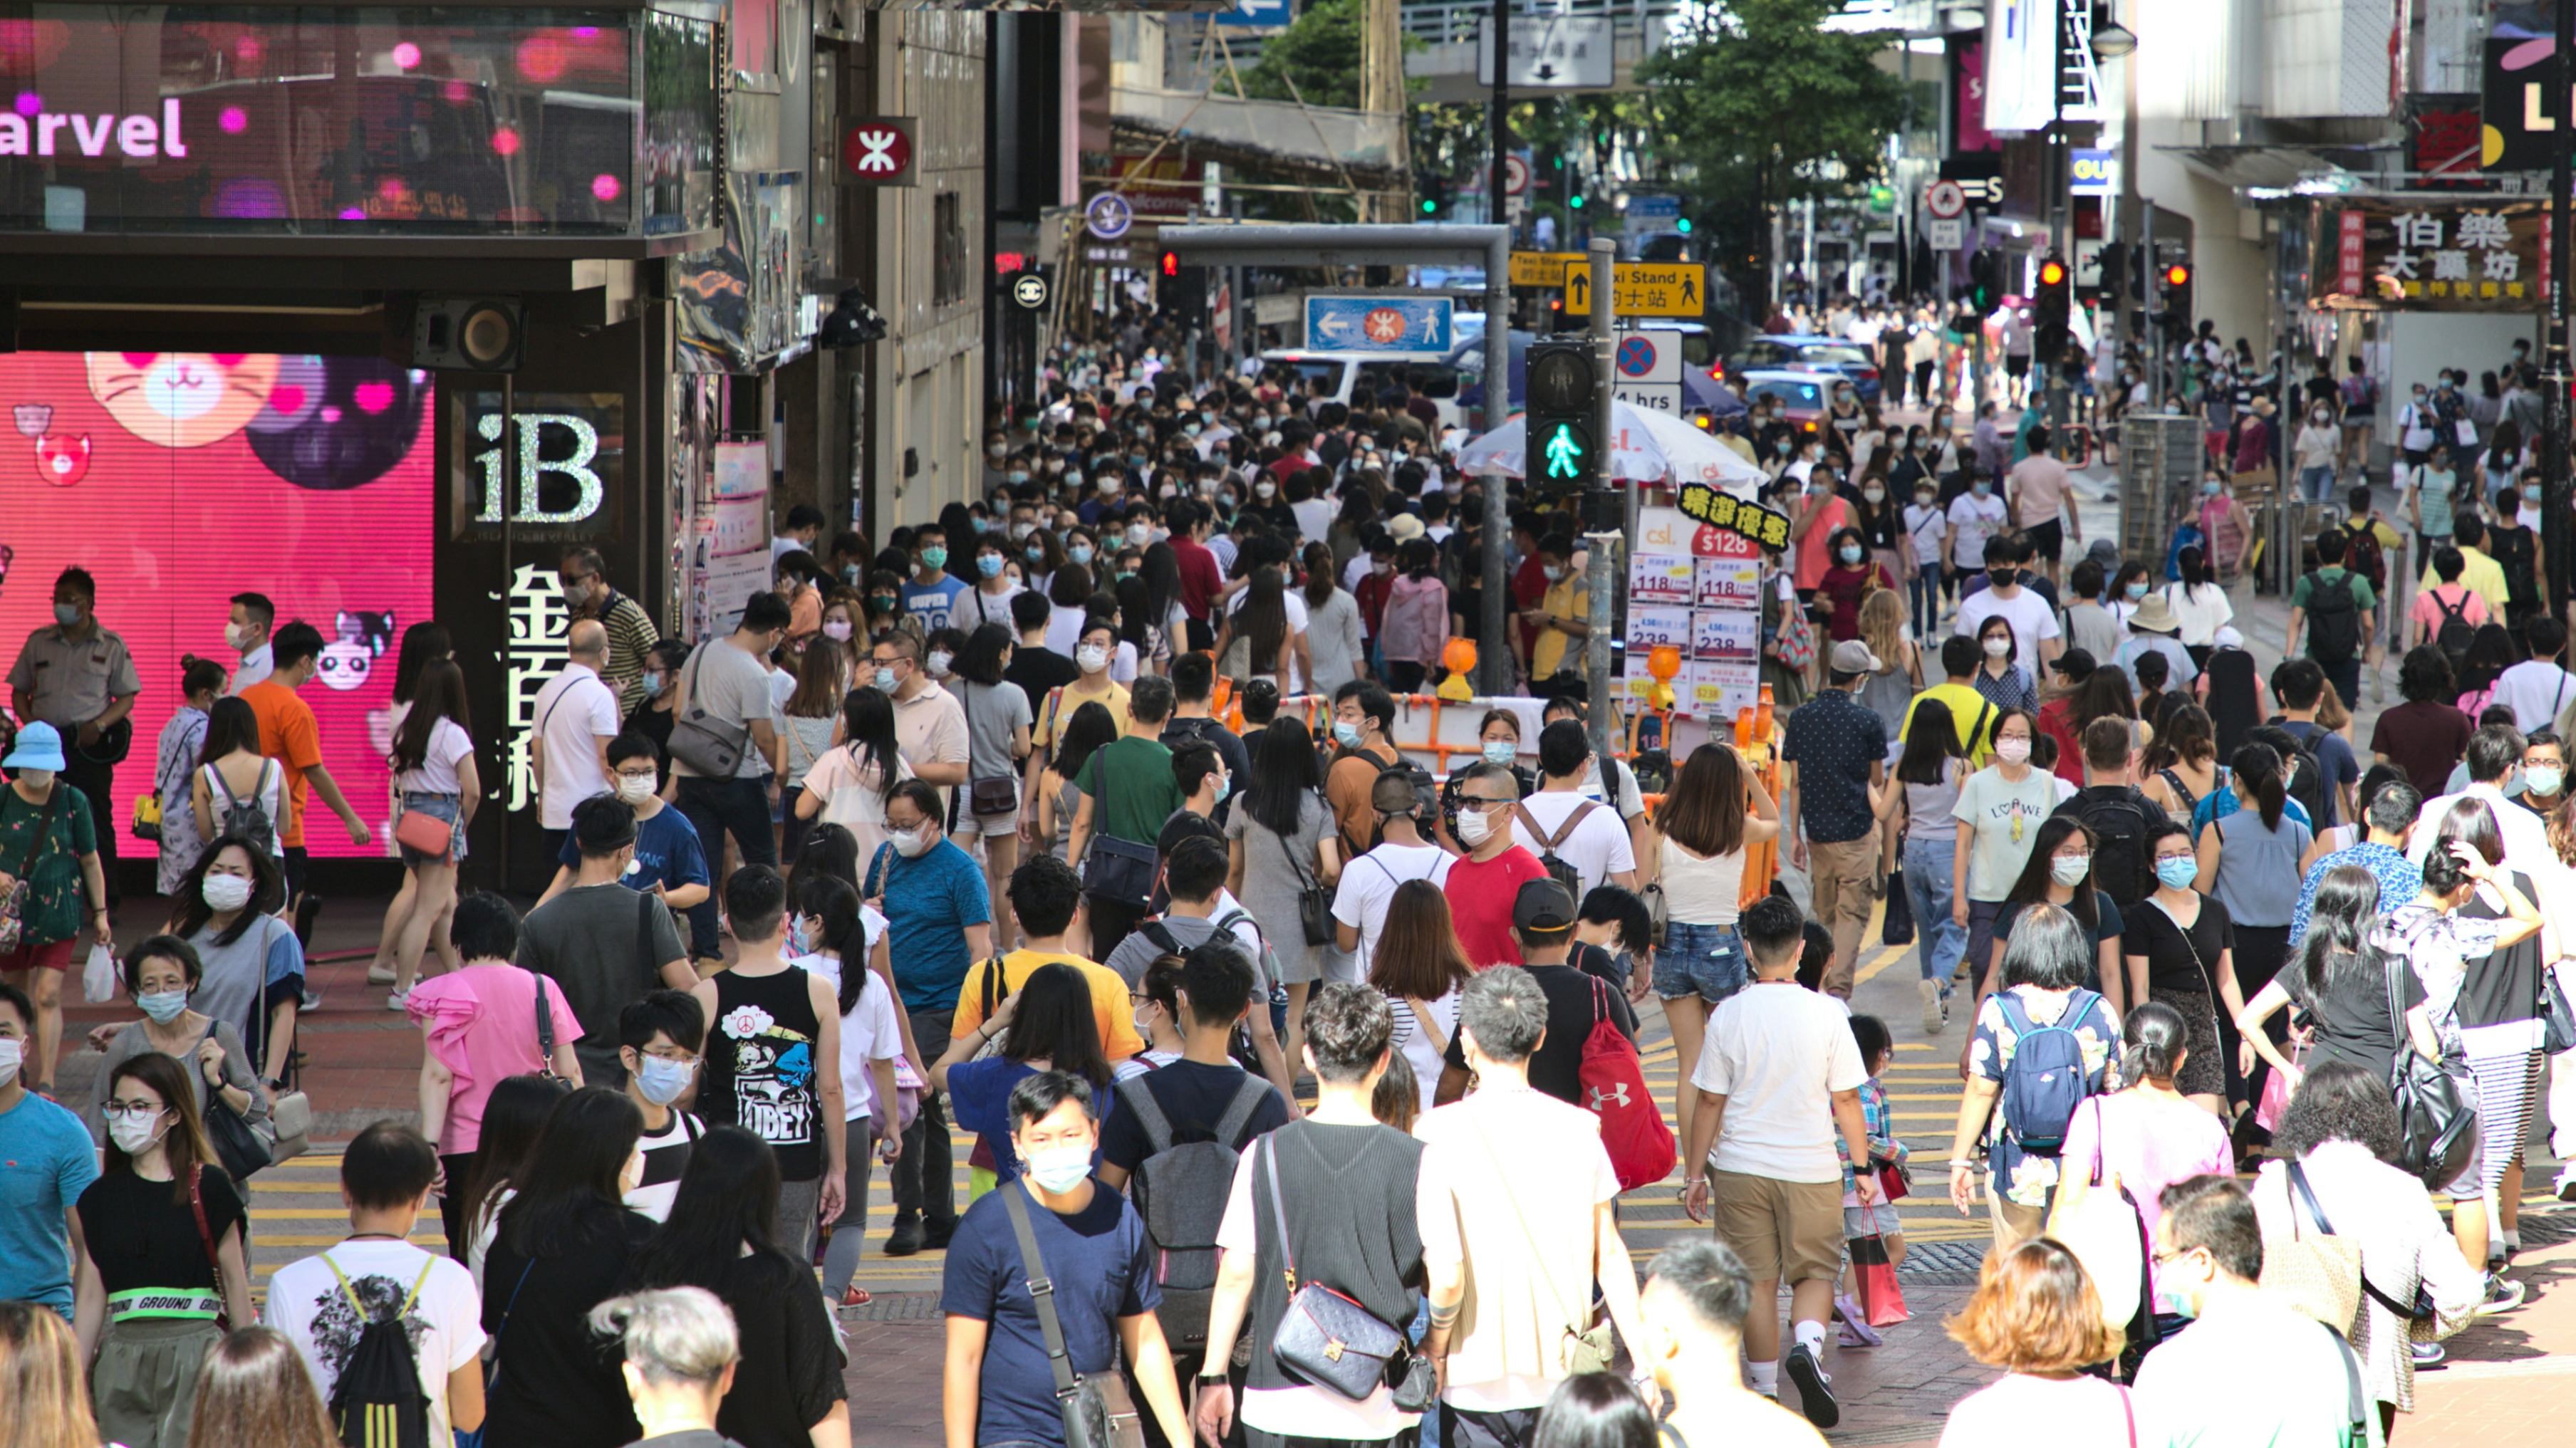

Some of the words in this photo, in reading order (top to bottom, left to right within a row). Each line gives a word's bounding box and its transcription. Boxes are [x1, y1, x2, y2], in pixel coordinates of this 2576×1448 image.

[0, 98, 187, 157] arvel
[1127, 194, 1192, 209] ellcome
[2391, 213, 2512, 249] 伯樂
[1540, 256, 1565, 266] Stan
[2384, 249, 2519, 280] 大藥坊
[1631, 271, 1676, 283] Stand
[1636, 392, 1670, 410] hrs
[474, 413, 603, 524] iB
[1682, 487, 1788, 548] 精選優惠
[1646, 524, 1676, 546] csl.
[1702, 532, 1747, 553] $128
[1638, 575, 1669, 590] 118
[1704, 580, 1735, 595] 118
[909, 593, 947, 610] SUPER
[1700, 636, 1735, 653] 238
[1697, 687, 1719, 699] $238
[745, 1103, 805, 1140] OBEY
[138, 1296, 192, 1311] GROUND
